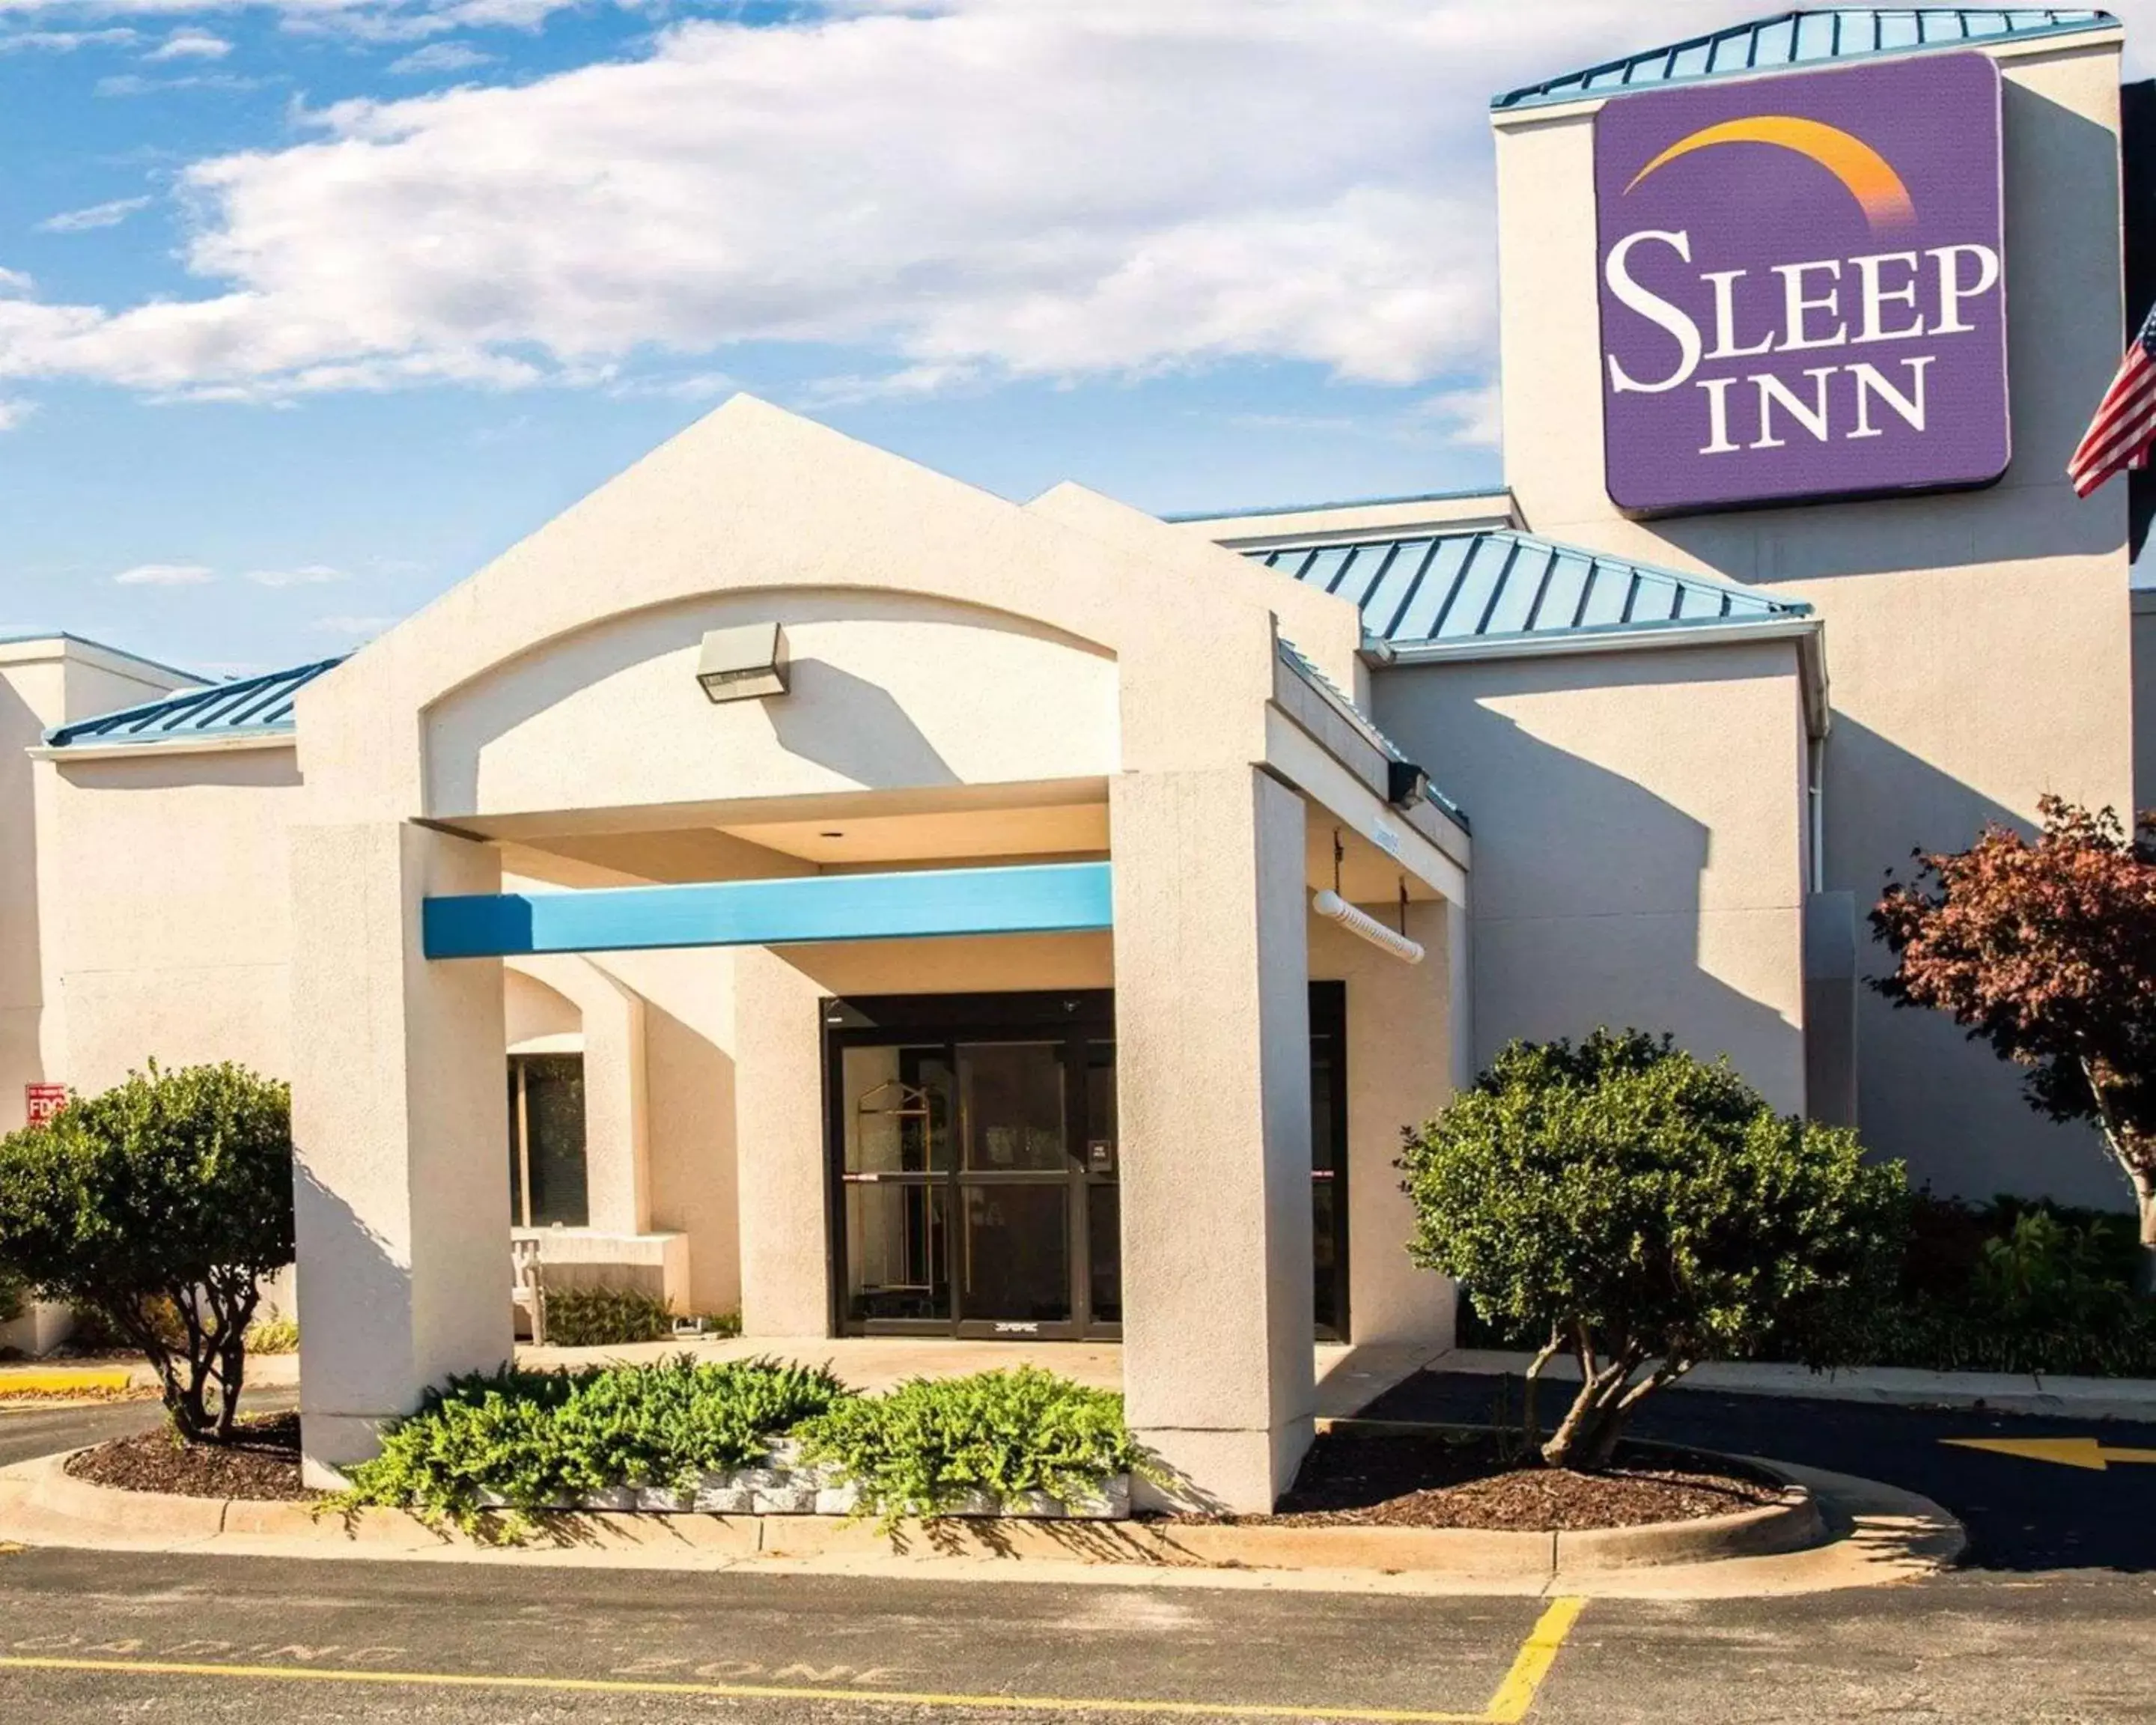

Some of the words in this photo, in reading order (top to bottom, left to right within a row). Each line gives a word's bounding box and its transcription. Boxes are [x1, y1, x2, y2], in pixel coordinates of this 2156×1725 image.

[1604, 229, 2000, 394] SLEEP
[1696, 355, 1937, 454] INN
[12, 1634, 409, 1662] OADING
[609, 1657, 933, 1685] ZONE
